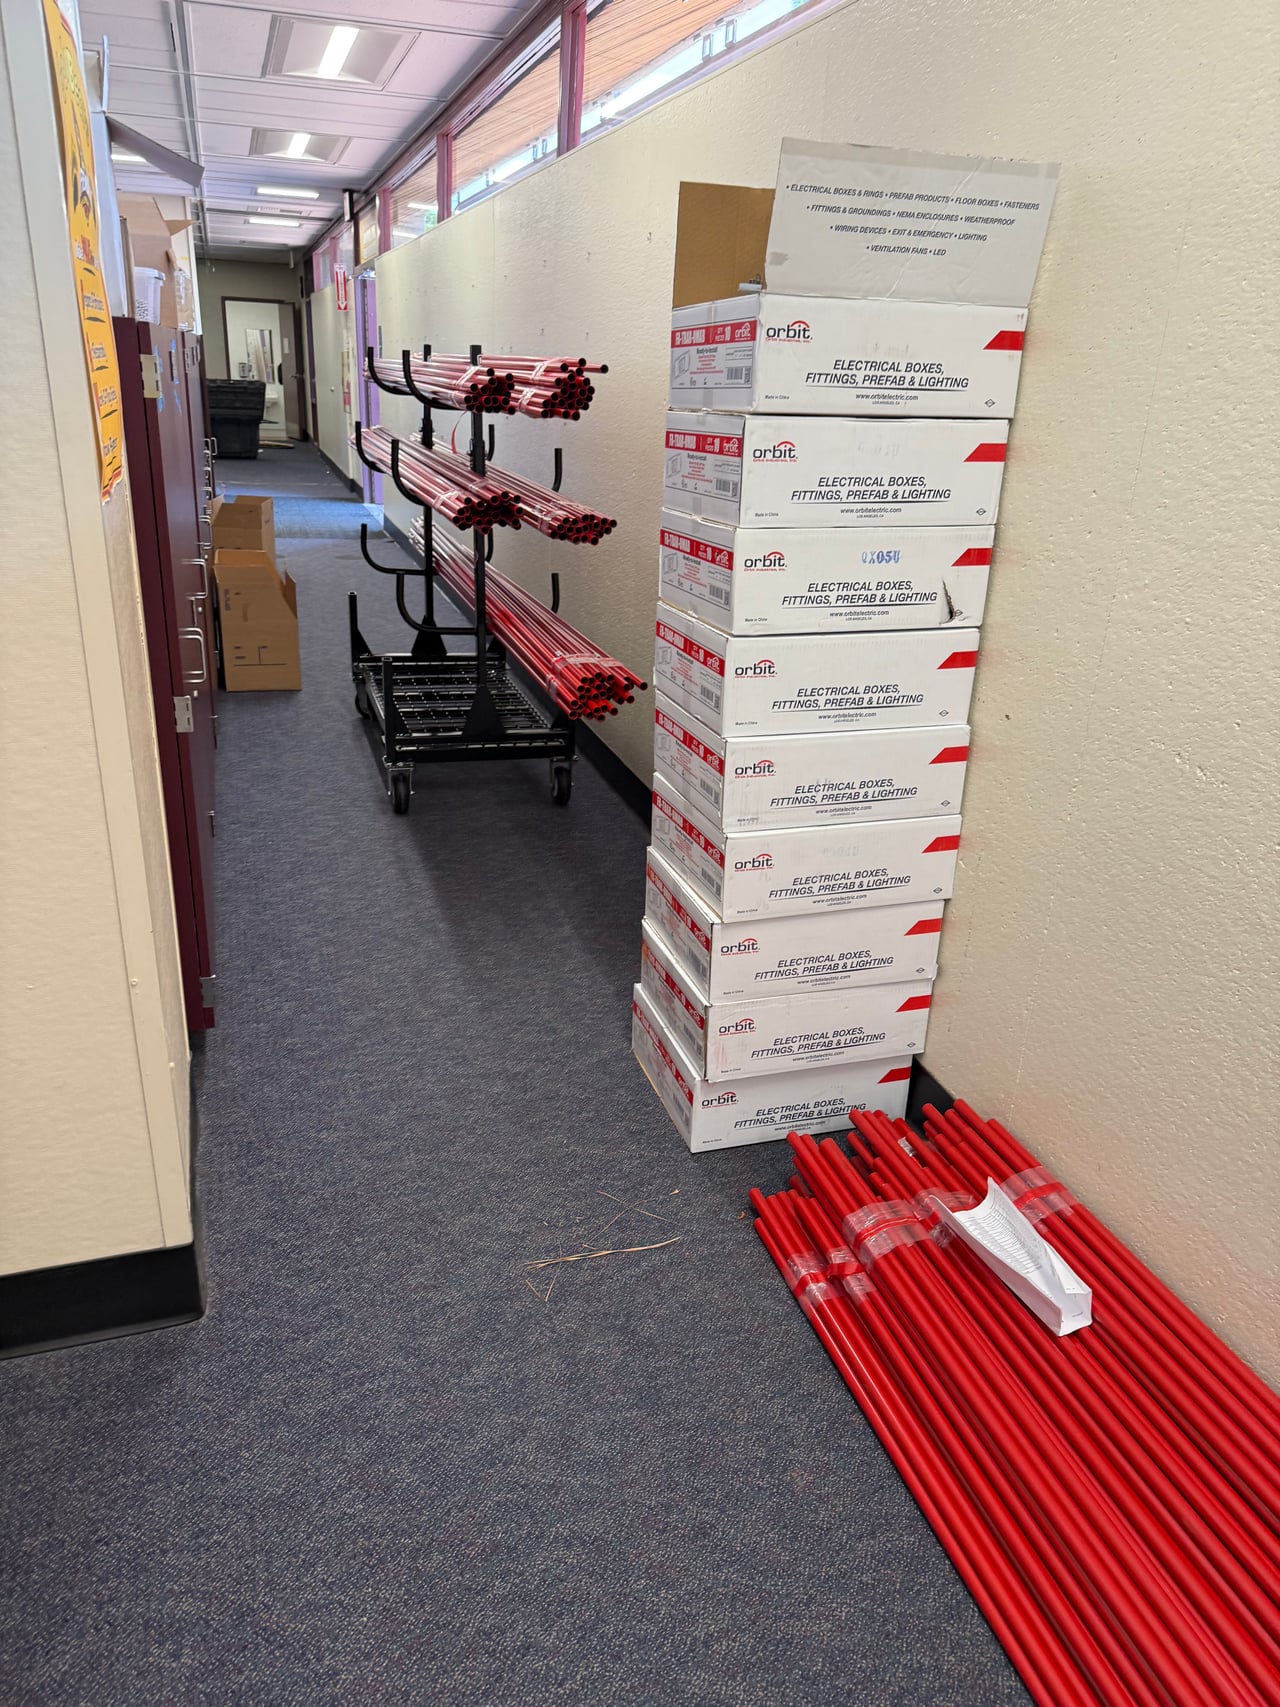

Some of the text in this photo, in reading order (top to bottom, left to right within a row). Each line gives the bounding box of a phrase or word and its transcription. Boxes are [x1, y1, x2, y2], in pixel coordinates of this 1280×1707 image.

[790, 184, 1039, 210] ELECTRICAL BOXES & RINGS PREFAB PRODUCTS FLOOR BOXES FASTENERS
[810, 204, 841, 213] FITTINGS
[847, 207, 891, 216] GROUNDINGS
[896, 210, 914, 219] NEMA
[915, 212, 959, 221] ENCLOSURES
[964, 215, 1015, 225] WEATHERPROOF
[834, 224, 858, 232] WIRING
[859, 226, 887, 234] DEVICES
[912, 229, 953, 238] EMERGENCY
[958, 233, 987, 241] LIGHTING
[870, 244, 910, 253] VENTILATION
[766, 325, 810, 339] orbit
[832, 359, 945, 373] ELECTRICAL BOXES,
[805, 372, 969, 389] FITTINGS, PREFAB & LIGHTING
[856, 393, 918, 401] www.orbitelectric.com
[753, 444, 796, 458] orbit
[817, 476, 927, 486] ELECTRICAL BOXES,
[790, 489, 951, 500] FITTINGS, PREFAB & LIGHTING
[744, 554, 785, 568] orbit
[807, 580, 914, 592] ELECTRICAL BOXES,
[781, 592, 938, 604] FITTINGS, PREFAB & LIGHTING
[735, 664, 775, 676] orbit
[796, 684, 901, 696] ELECTRICAL BOXES,
[771, 694, 924, 709] FITTINGS, PREFAB & LIGHTING
[818, 711, 876, 719] www.orbitelectric.com
[735, 763, 774, 776] orbit
[794, 779, 895, 793] ELECTRICAL BOXES,
[769, 788, 918, 807] FITTINGS, PREFAB & LIGHTING
[734, 857, 772, 869] orbit
[792, 868, 889, 884] ELECTRICAL BOXES,
[768, 876, 911, 897] FITTINGS, PREFAB & LIGHTING
[721, 941, 758, 953] orbit
[777, 950, 872, 967] ELECTRICAL BOXES,
[754, 957, 894, 980] FITTINGS, PREFAB & LIGHTING
[719, 1020, 754, 1033] orbit
[772, 1027, 865, 1046] ELECTRICAL BOXES,
[750, 1046, 795, 1058] FITTINGS,
[796, 1041, 833, 1052] PREFAB
[843, 1033, 886, 1046] LIGHTING
[702, 1094, 737, 1107] orbit
[755, 1098, 846, 1115] ELECTRICAL BOXES,
[733, 1116, 777, 1129] FITTINGS,
[778, 1111, 816, 1123] PREFAB
[814, 1110, 824, 1118] &
[822, 1104, 867, 1117] LIGHTING
